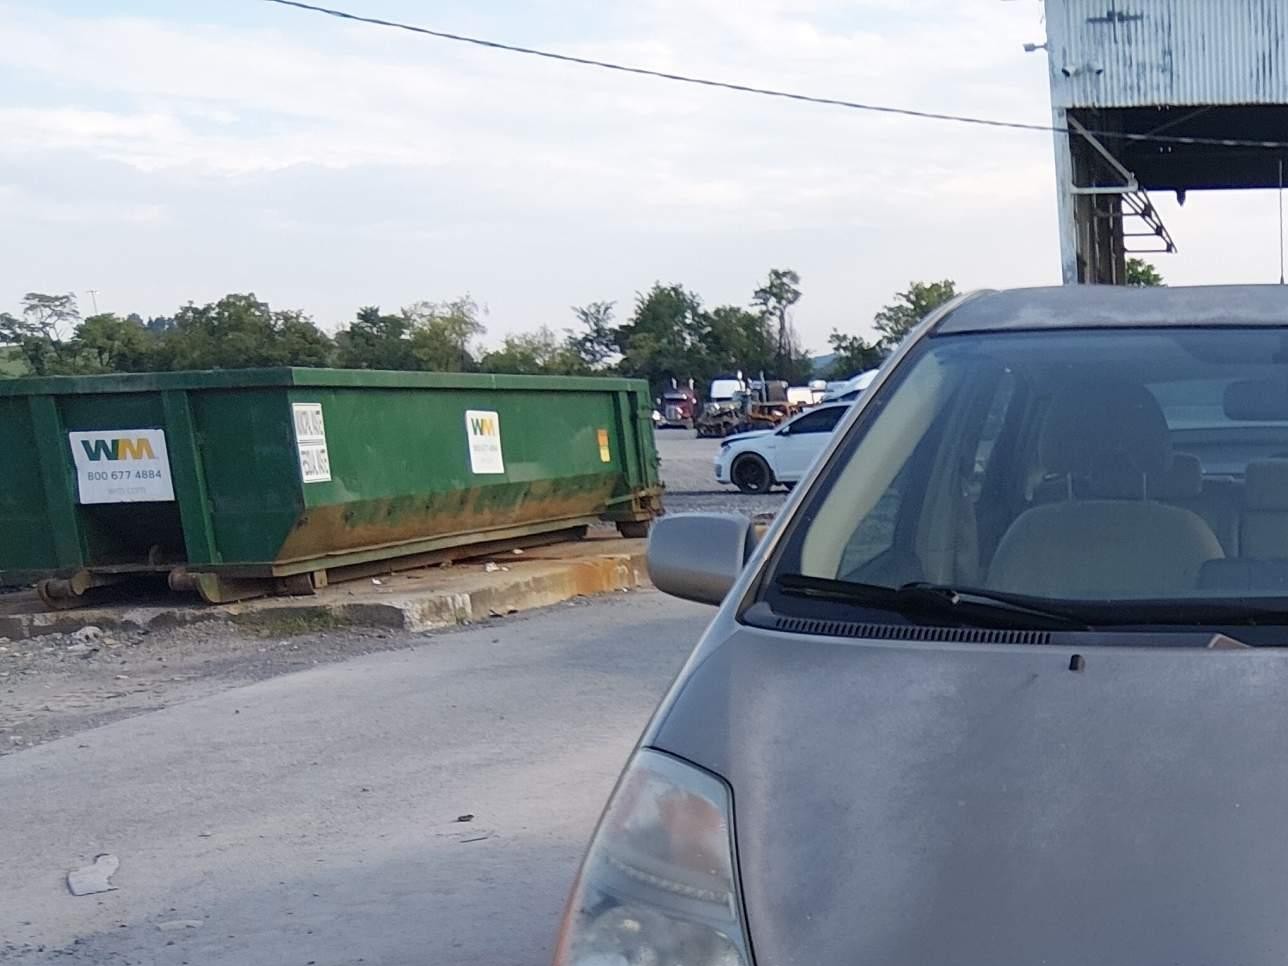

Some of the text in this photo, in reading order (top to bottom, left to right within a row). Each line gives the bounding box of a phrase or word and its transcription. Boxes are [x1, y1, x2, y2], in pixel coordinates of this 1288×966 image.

[471, 417, 495, 436] WM
[81, 438, 155, 461] WM
[88, 470, 162, 480] 800 677 4884
